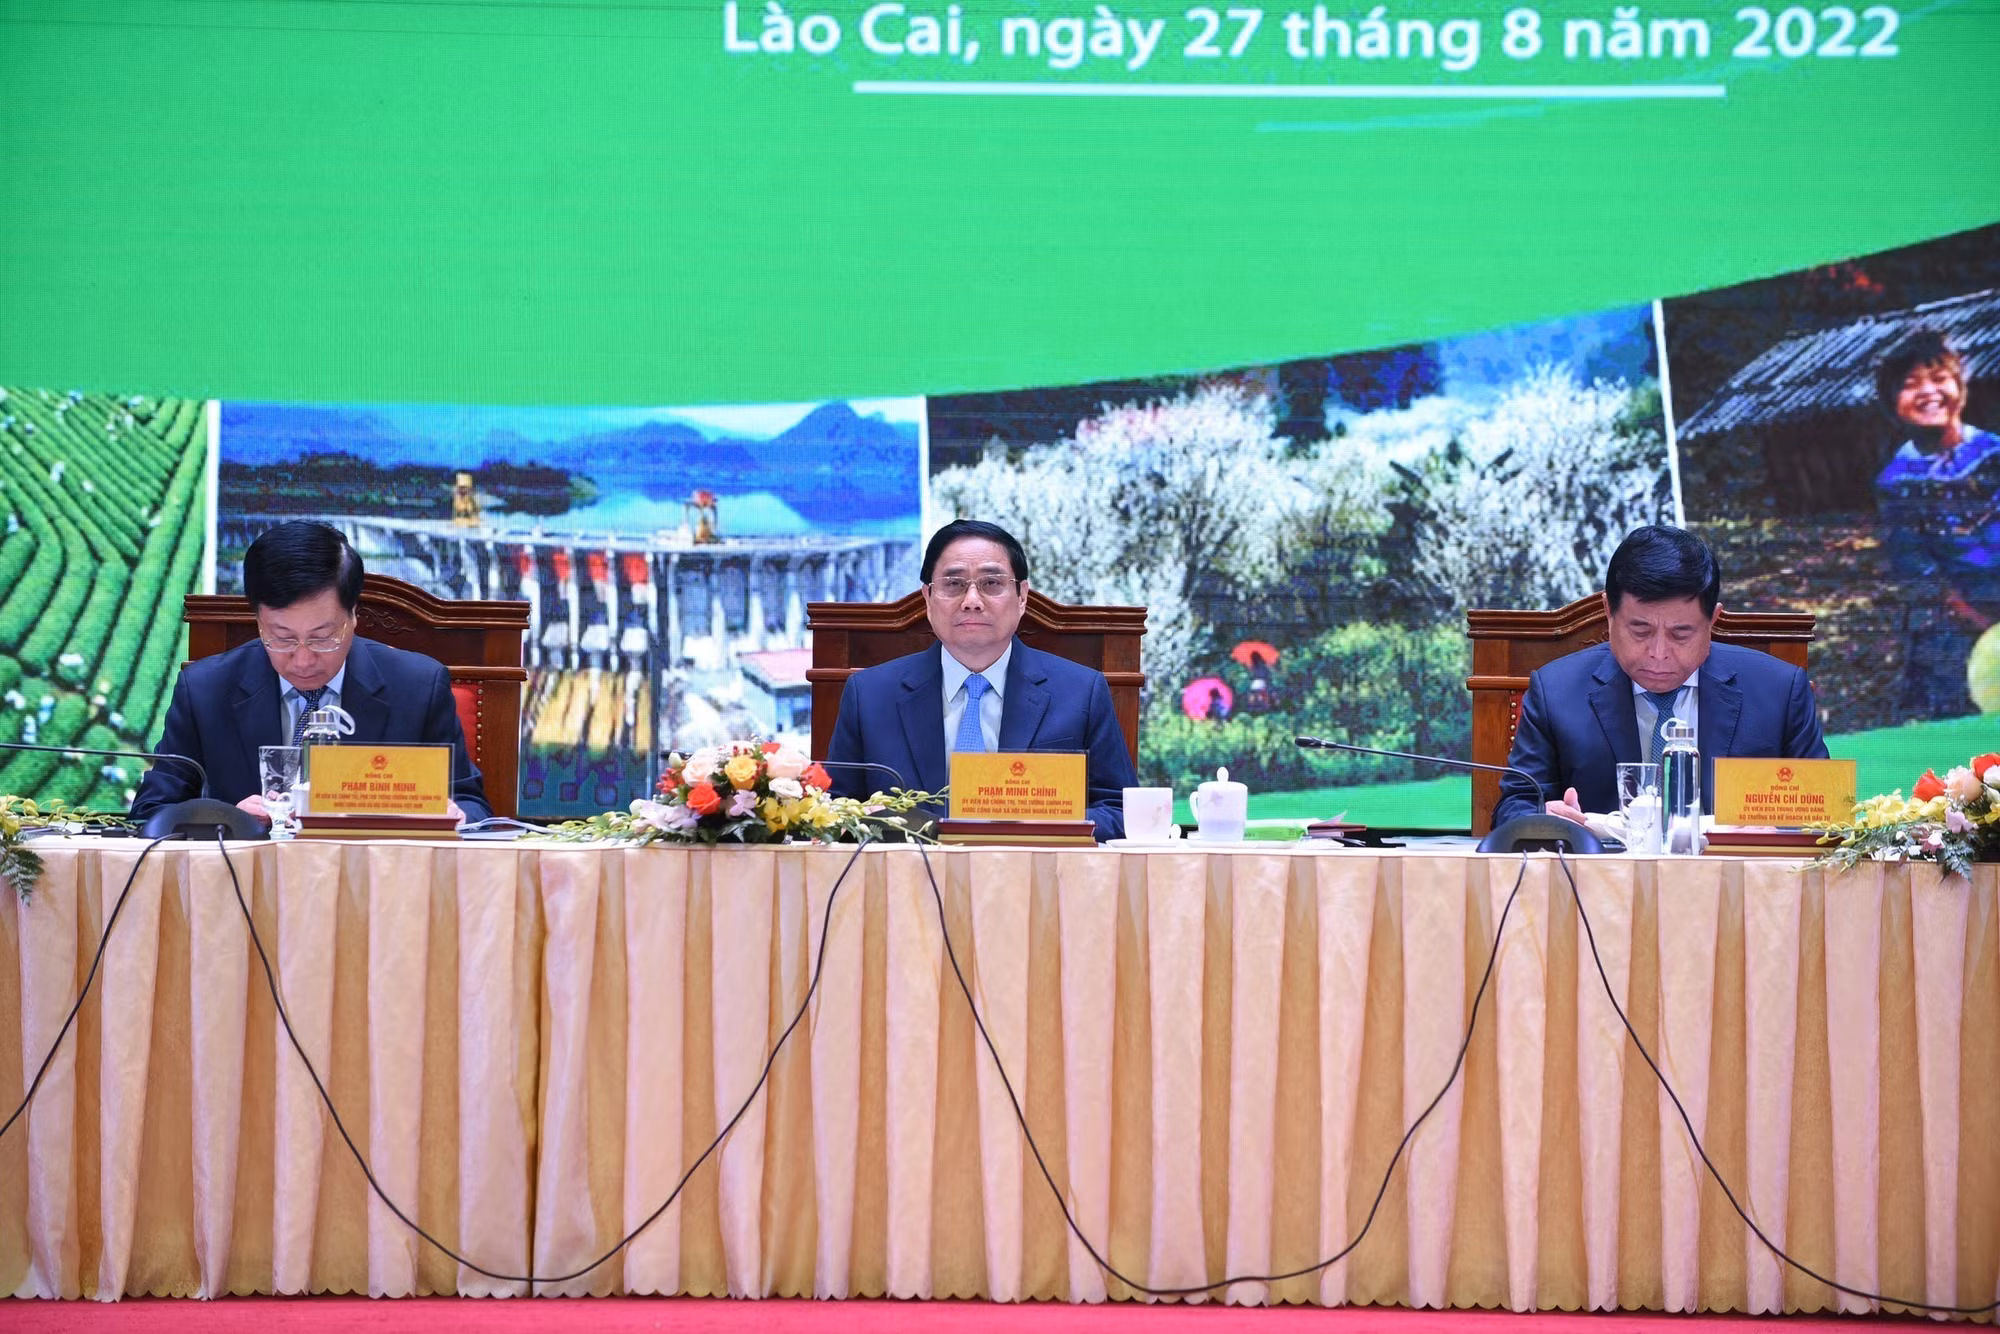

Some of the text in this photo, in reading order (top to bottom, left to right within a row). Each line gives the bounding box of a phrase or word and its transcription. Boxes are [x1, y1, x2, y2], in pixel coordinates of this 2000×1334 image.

[723, 0, 1898, 71] Lào Cai, ngày 27 tháng 8 năm 2022
[341, 780, 416, 793] PHẠM BÌNH MINH
[978, 785, 1057, 798] PHẠM MINH CHÍNH
[1745, 791, 1824, 805] NGUYỄN CHÍ DŨNG
